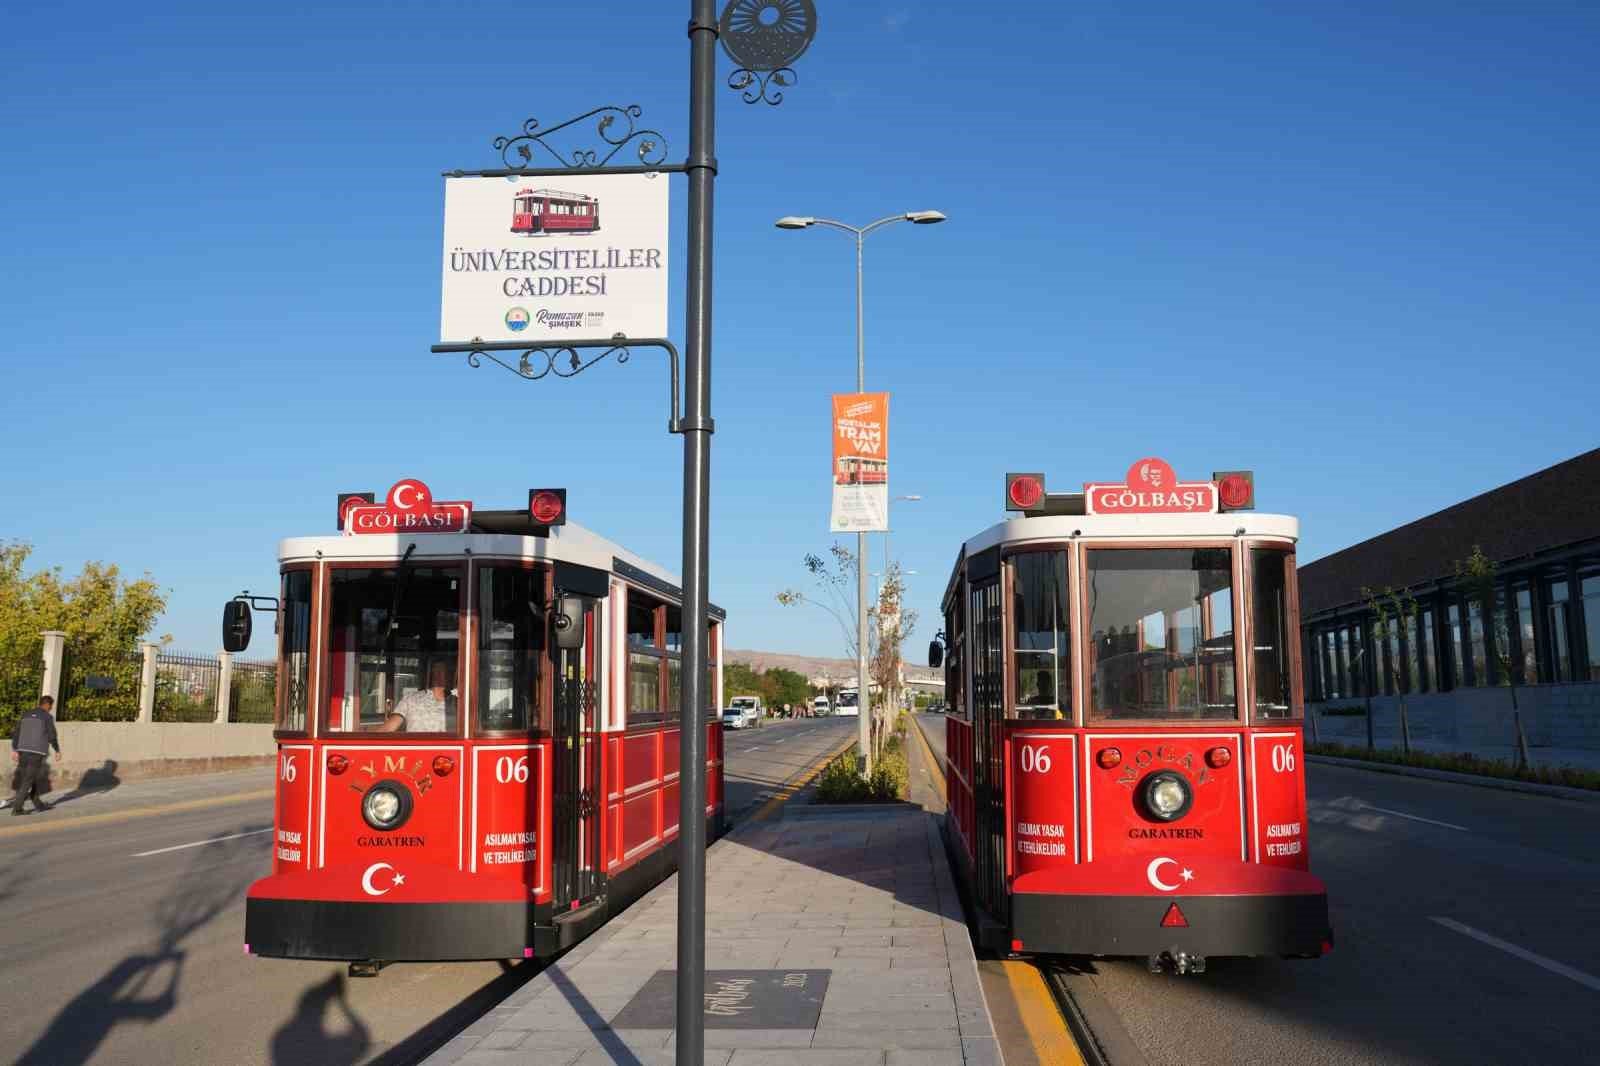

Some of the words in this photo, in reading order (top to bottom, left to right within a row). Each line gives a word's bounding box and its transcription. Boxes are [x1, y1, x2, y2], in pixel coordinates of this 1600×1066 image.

[450, 246, 661, 272] ÜNİVERSİTELİLER
[502, 273, 607, 297] CADDESİ
[838, 426, 881, 441] TRAM
[852, 438, 881, 454] VAY
[1101, 489, 1206, 510] GÖLBAŞI
[1021, 745, 1052, 774] 06
[1271, 743, 1296, 773] 06
[495, 755, 529, 784] 06
[357, 836, 425, 848] GARATREN
[1128, 828, 1203, 839] GARATREN
[483, 851, 494, 864] VE
